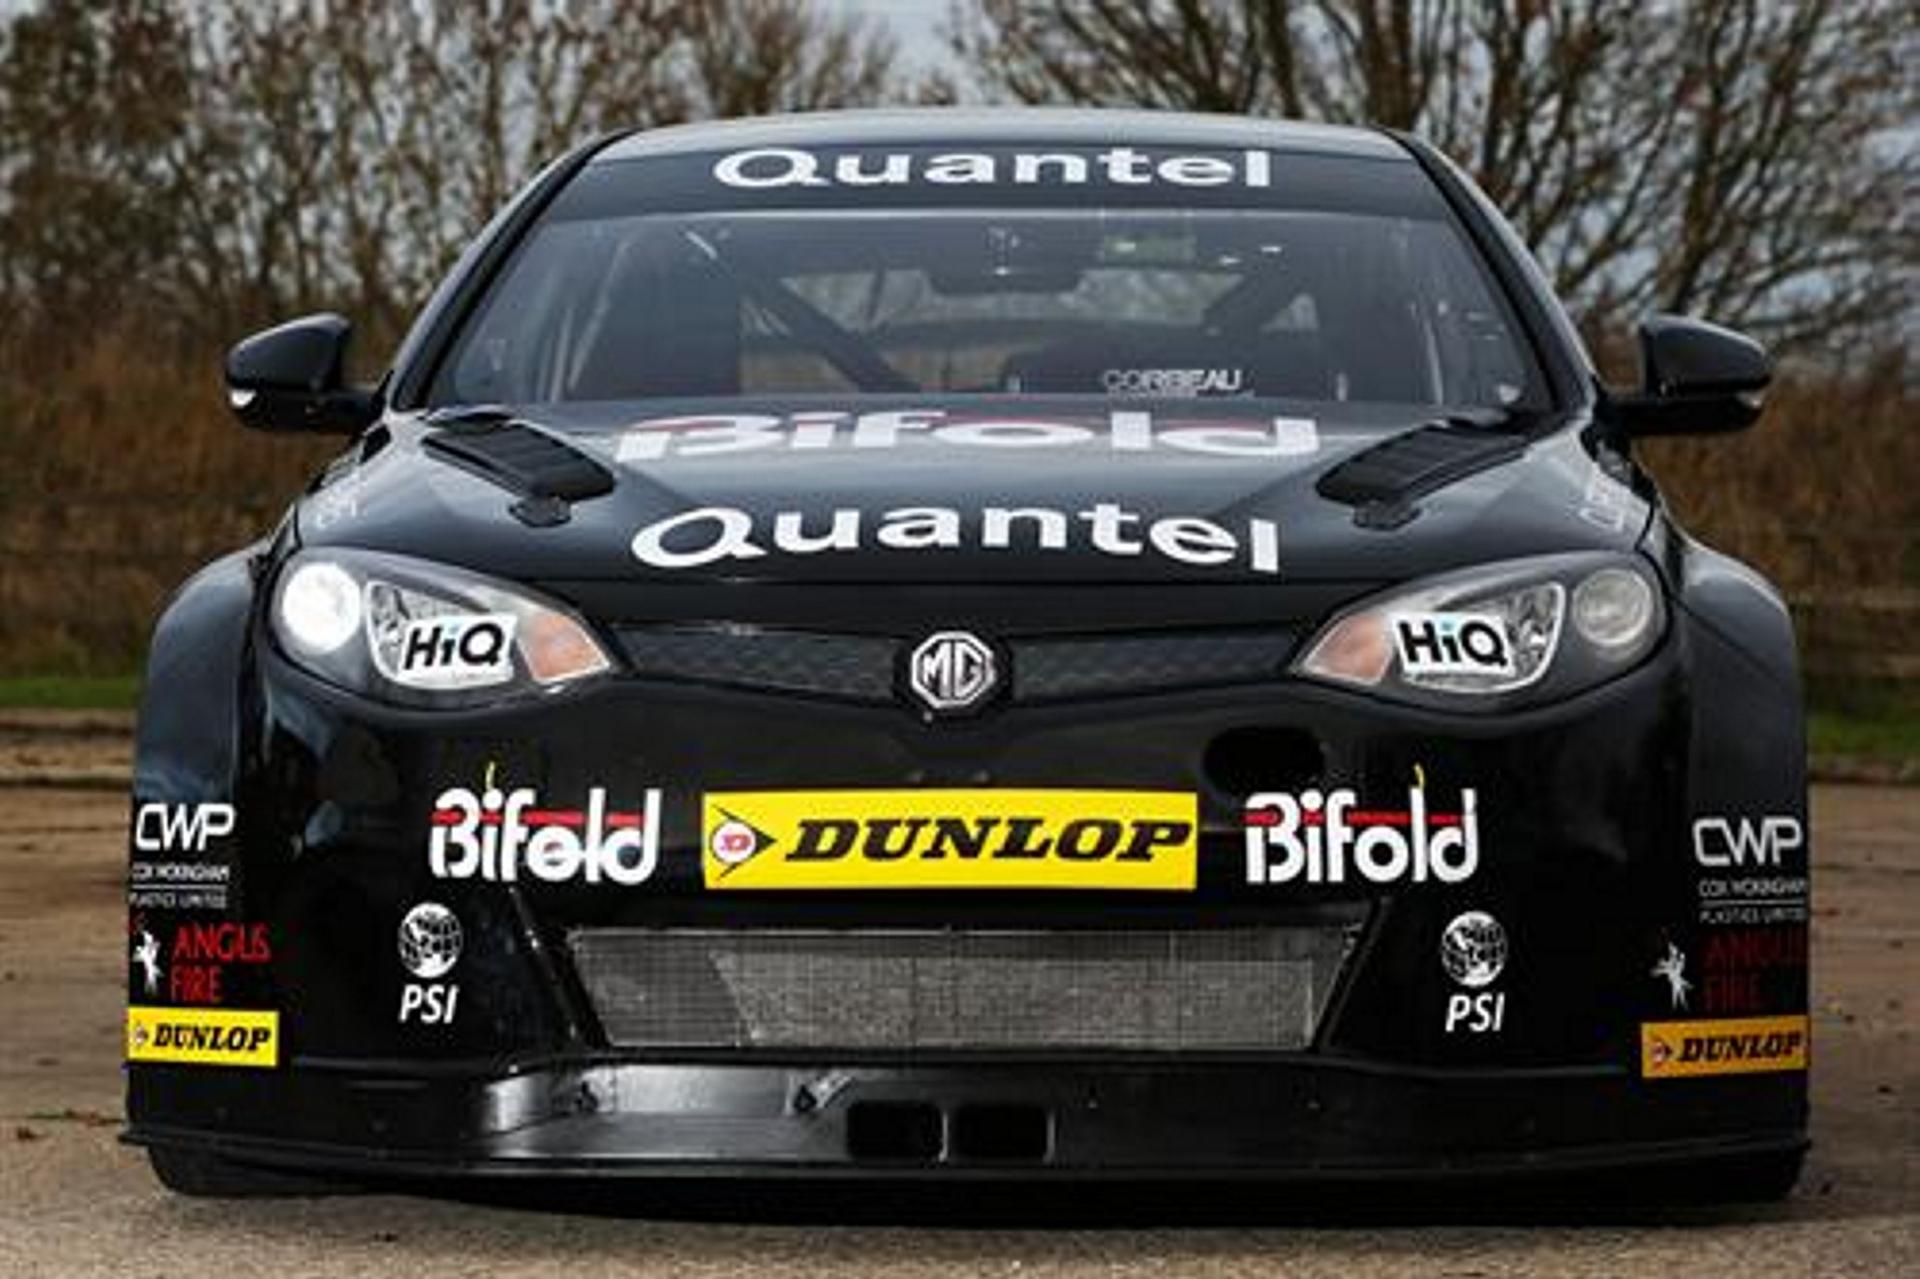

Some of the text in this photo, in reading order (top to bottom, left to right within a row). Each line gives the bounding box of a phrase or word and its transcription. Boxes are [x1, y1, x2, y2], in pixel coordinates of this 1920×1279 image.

[714, 148, 1270, 188] Quantel
[1104, 369, 1241, 391] CORBEAU
[614, 410, 1320, 462] Bifold
[630, 502, 1279, 573] Quantel
[403, 621, 504, 670] HiQ
[1399, 618, 1507, 667] HiQ
[923, 642, 983, 698] MG
[135, 803, 236, 851] CWP
[429, 786, 661, 885] Bifold
[786, 818, 1193, 863] DUNLOP
[1242, 787, 1479, 884] Bifold
[1692, 816, 1802, 866] CWP
[171, 922, 272, 962] ANGUS
[170, 965, 222, 1003] FIRE
[399, 984, 459, 1025] PSI
[1446, 993, 1505, 1033] PSI
[153, 1022, 271, 1052] DUNLOP
[1679, 1029, 1802, 1063] DUNLOP
